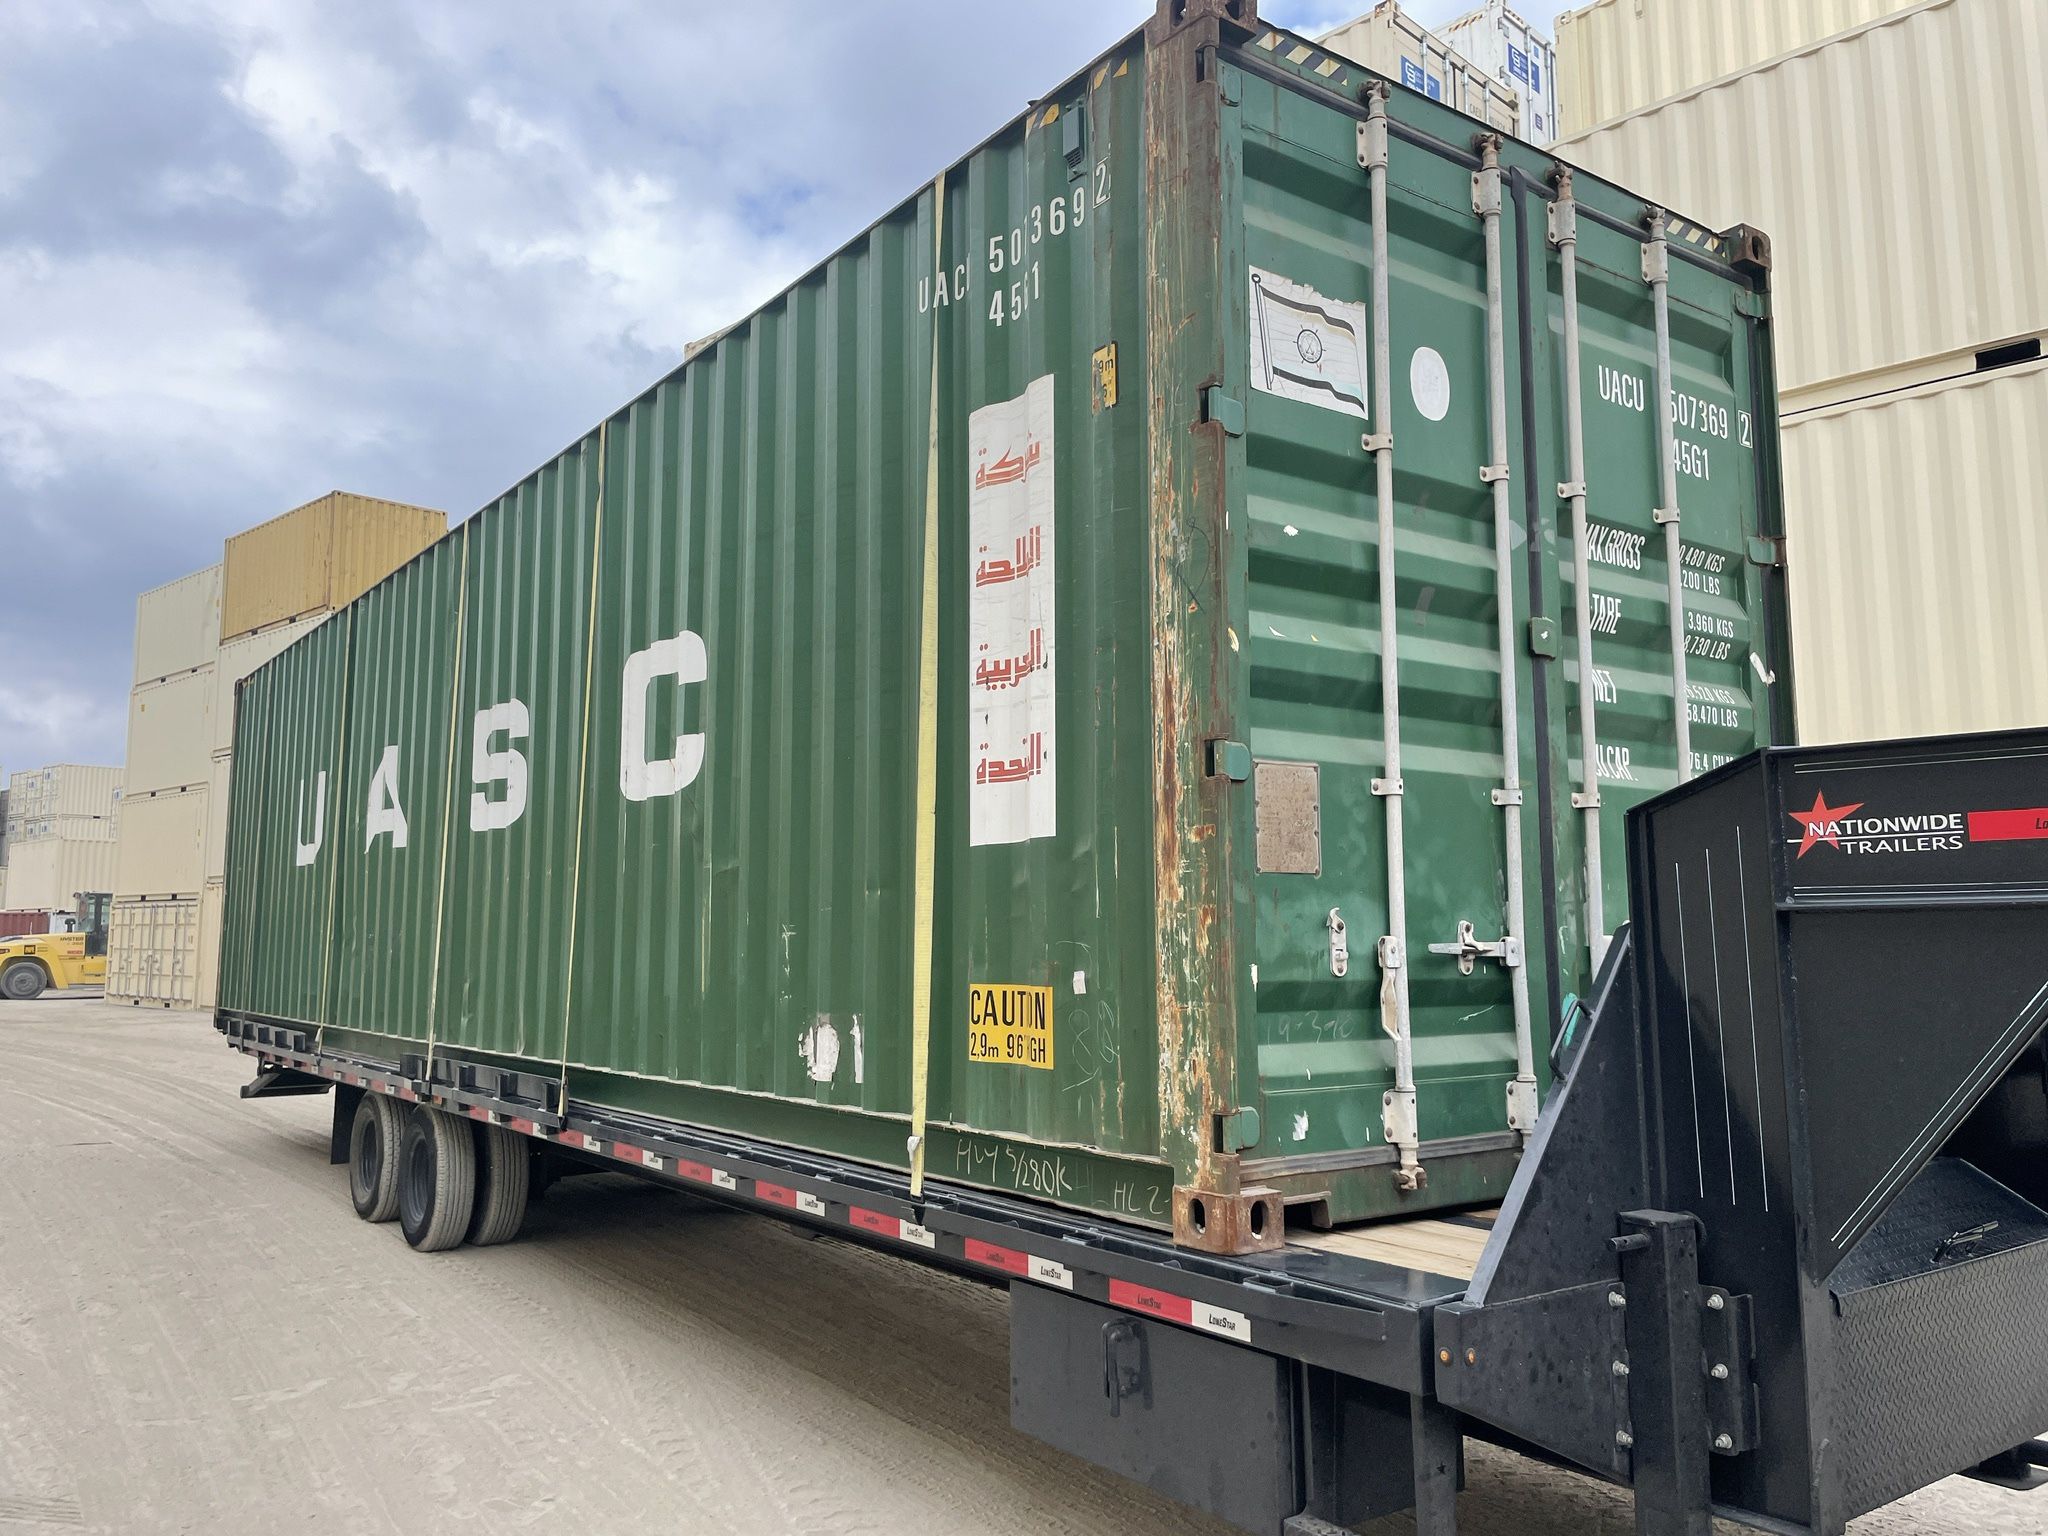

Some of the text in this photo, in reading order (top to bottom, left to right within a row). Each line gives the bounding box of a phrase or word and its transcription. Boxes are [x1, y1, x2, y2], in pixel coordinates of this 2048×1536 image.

[1094, 161, 1108, 205] 2
[1598, 364, 1751, 446] UACU 507369 2
[1672, 437, 1710, 481] 45G1
[1704, 552, 1727, 573] KGS
[1702, 574, 1721, 597] LBS
[1590, 593, 1622, 635] TARE
[1716, 617, 1735, 639] KGS
[1709, 640, 1732, 662] LBS
[1592, 668, 1617, 704] NET
[1712, 687, 1736, 705] KGS
[1720, 707, 1739, 729] LBS
[297, 630, 707, 867] UASC
[1595, 743, 1640, 782] U.CAP.
[1807, 813, 1964, 838] NATIONWIDE
[1840, 835, 1964, 855] TRAILERS
[971, 989, 1046, 1030] CAUTON
